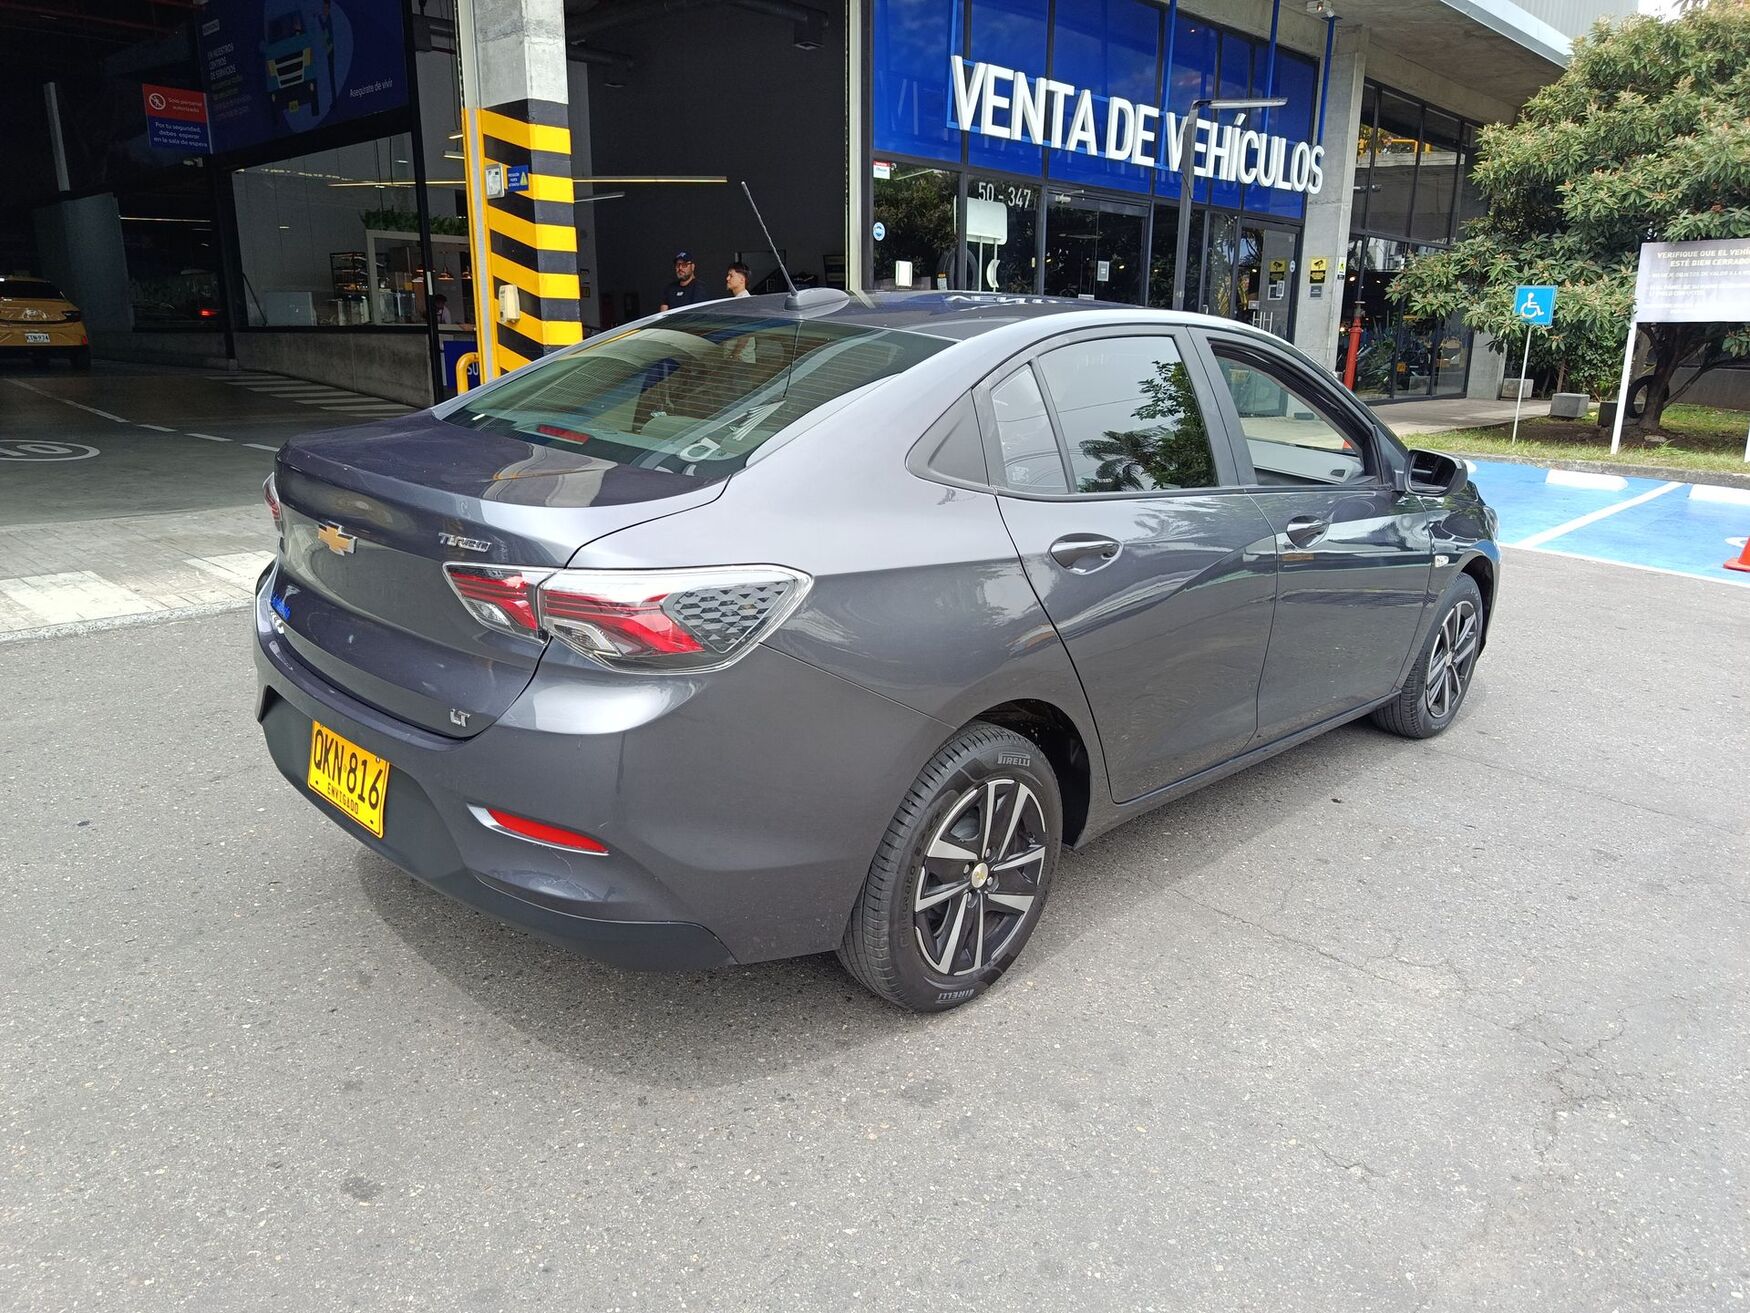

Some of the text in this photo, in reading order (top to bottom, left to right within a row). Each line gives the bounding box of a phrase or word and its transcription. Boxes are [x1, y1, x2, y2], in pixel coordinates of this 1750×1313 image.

[951, 55, 1325, 195] VENTA DE VEHÍCULOS
[979, 182, 995, 203] 50
[1008, 186, 1032, 209] 347
[1657, 251, 1698, 260] VERIFIQUE
[1700, 249, 1716, 258] QUE
[1718, 248, 1728, 257] EL
[1670, 258, 1690, 268] ESTÉ
[438, 532, 492, 553] TURBO
[450, 709, 470, 727] LT
[997, 751, 1031, 767] PIRELLI
[314, 729, 383, 811] QKN 816
[327, 782, 359, 815] ENVIGADO
